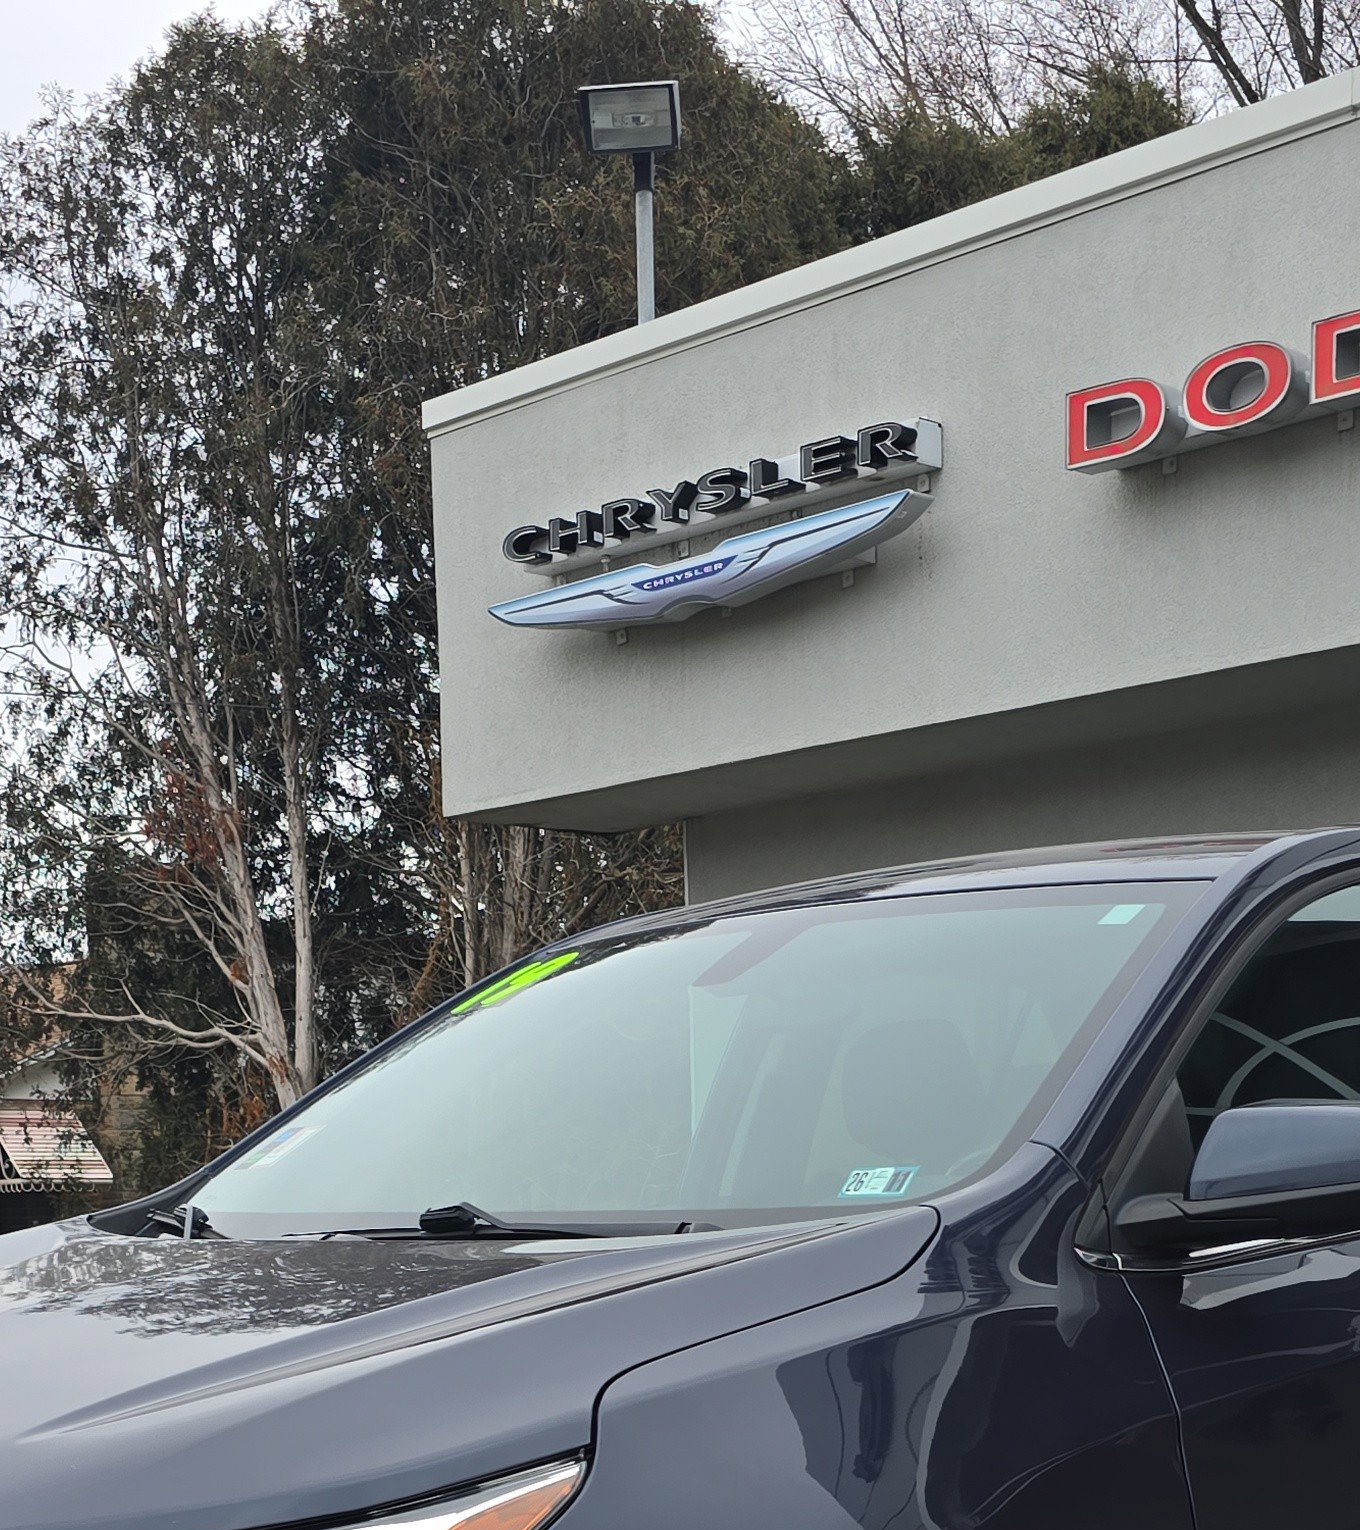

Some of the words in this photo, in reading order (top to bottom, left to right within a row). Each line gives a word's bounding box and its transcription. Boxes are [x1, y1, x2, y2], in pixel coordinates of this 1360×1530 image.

[502, 420, 918, 565] CHRYSLER
[642, 562, 724, 590] CHRYSLER
[845, 1172, 869, 1192] 26
